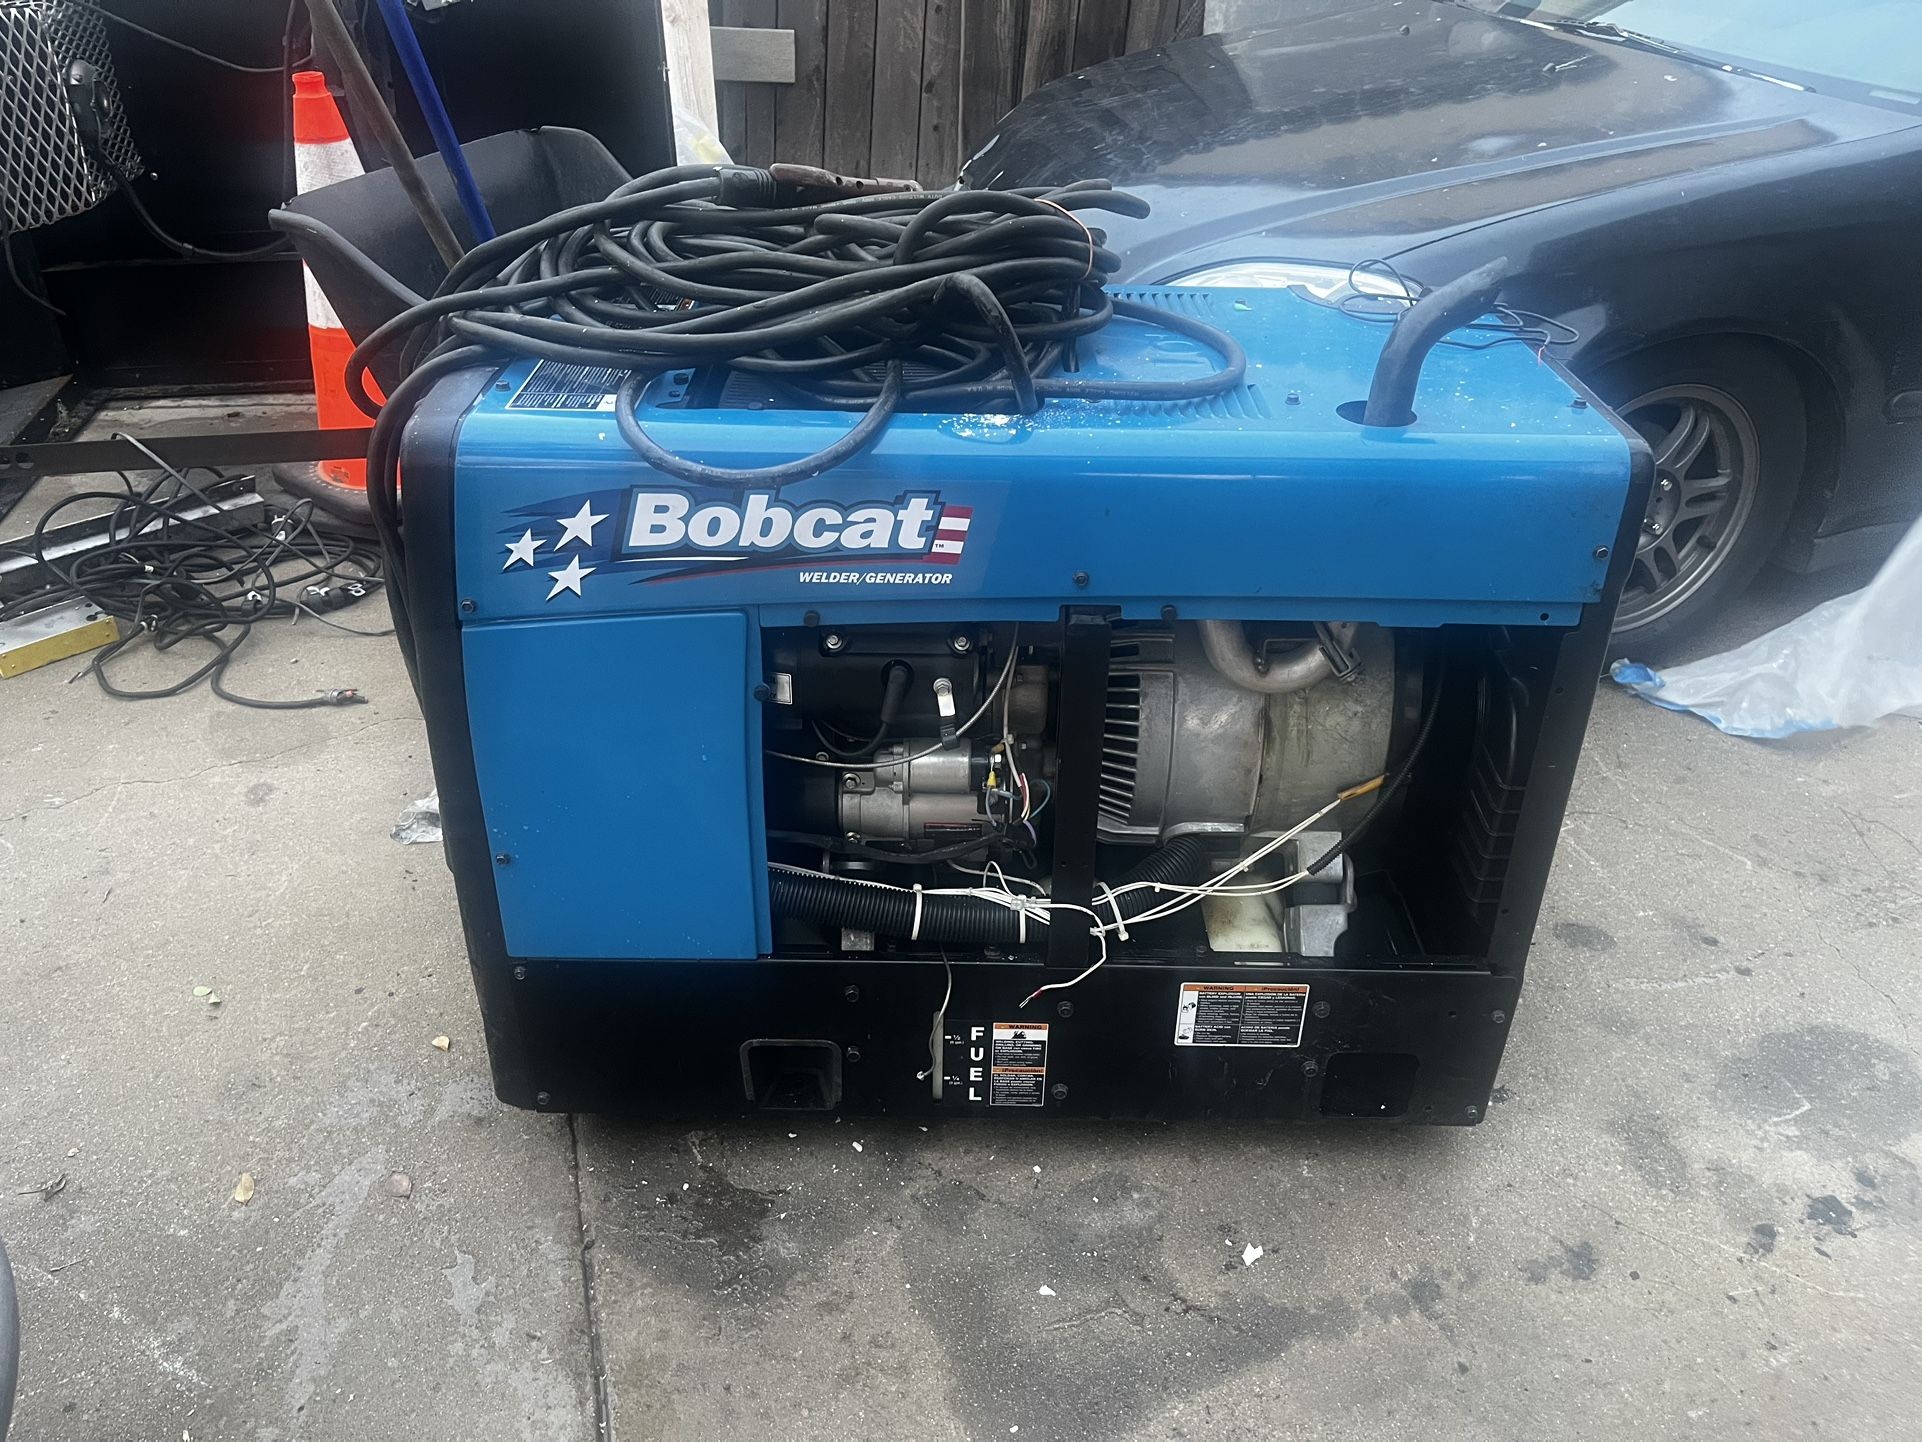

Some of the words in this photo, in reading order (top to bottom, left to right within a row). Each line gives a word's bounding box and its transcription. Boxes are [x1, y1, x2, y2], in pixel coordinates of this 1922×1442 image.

[628, 493, 934, 549] Bobcat
[799, 571, 953, 585] WELDER/GENERATOR
[968, 1026, 985, 1101] FUEL
